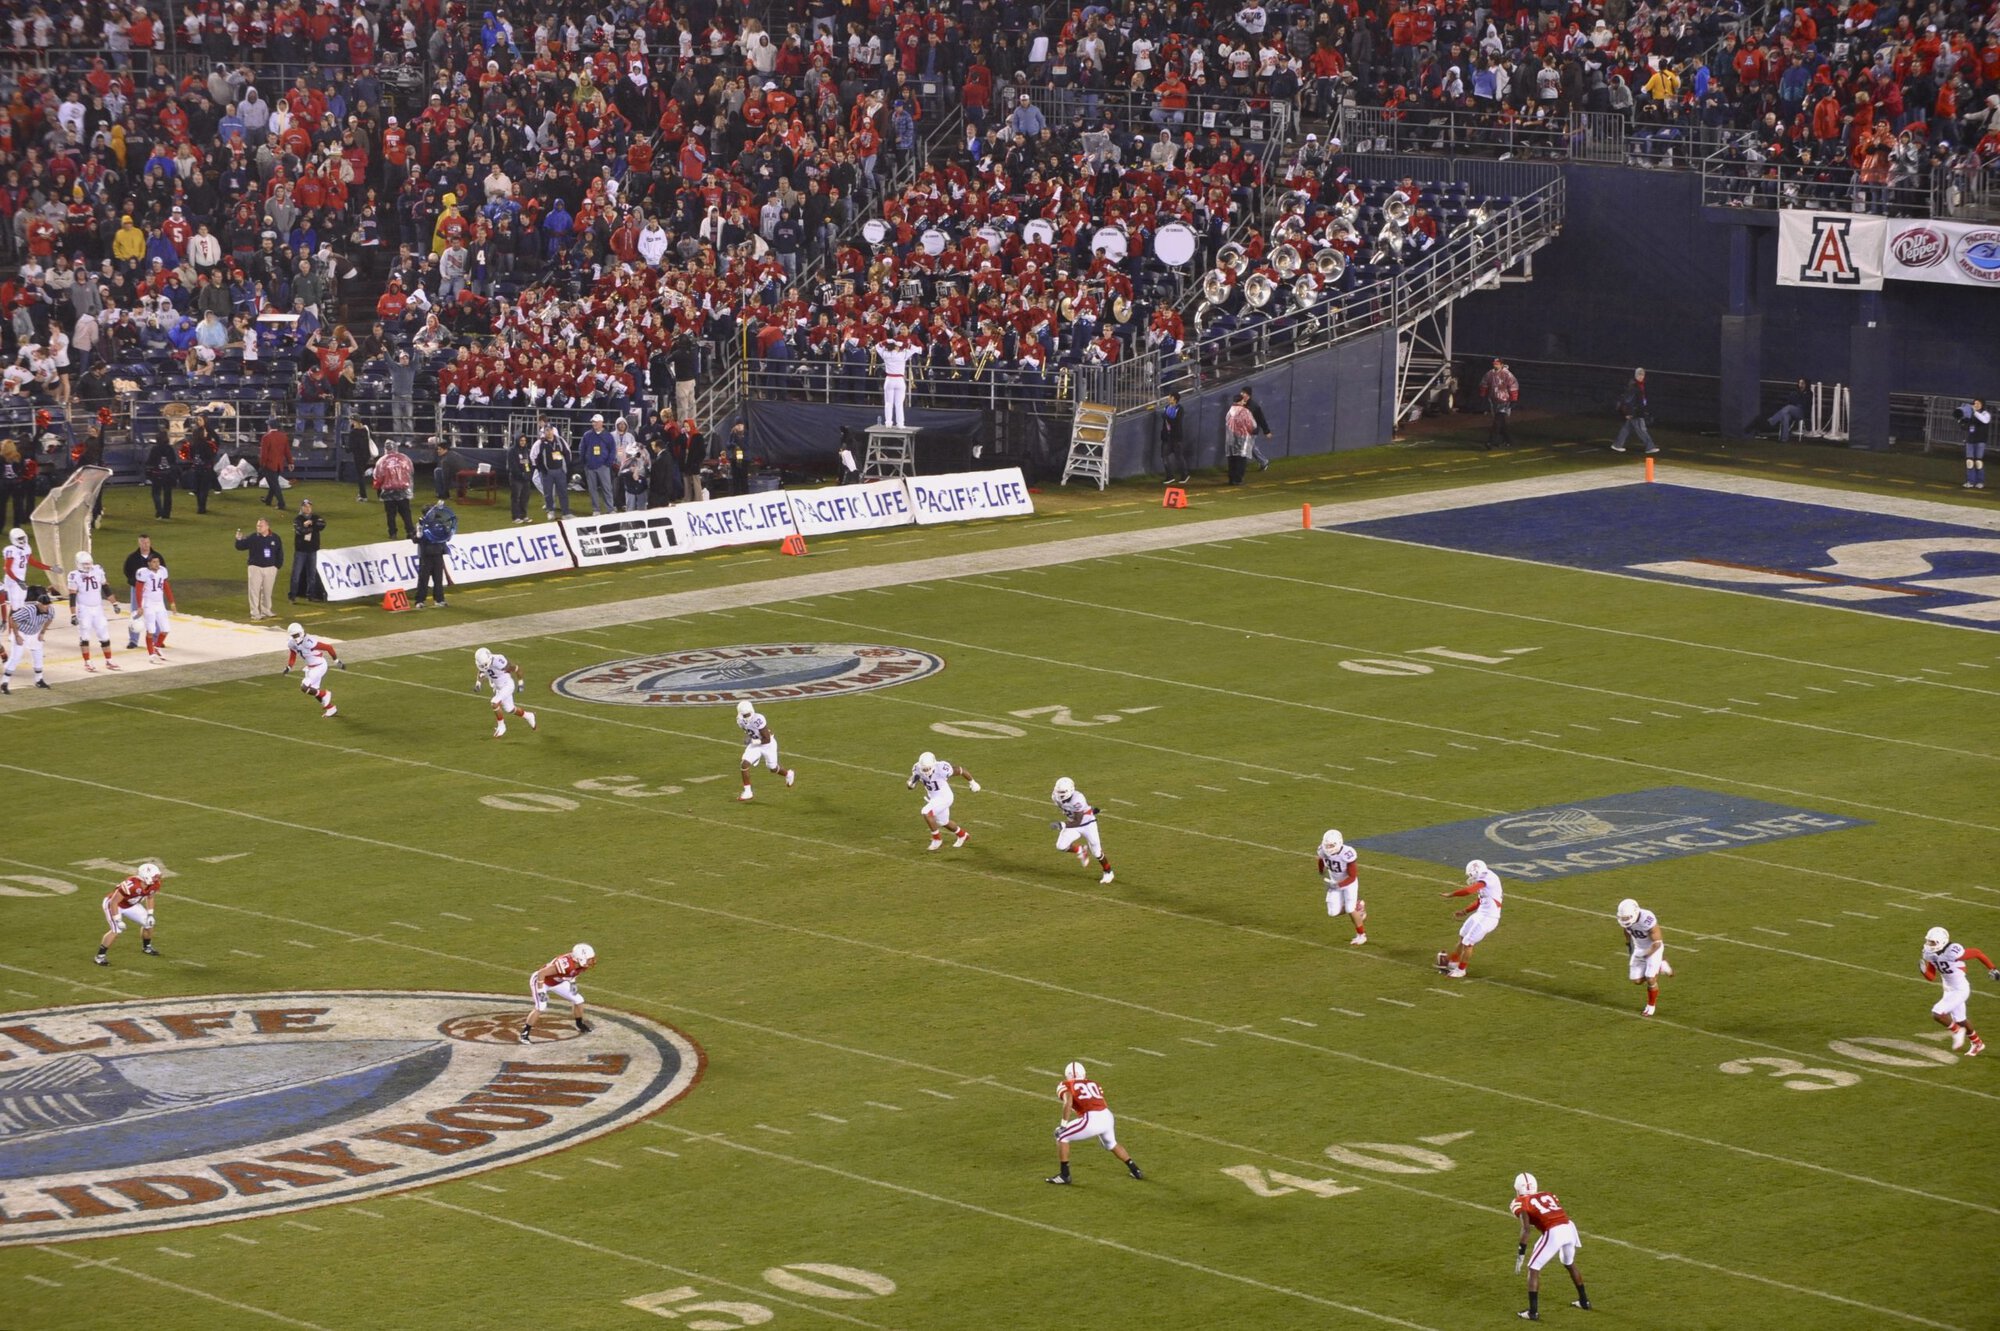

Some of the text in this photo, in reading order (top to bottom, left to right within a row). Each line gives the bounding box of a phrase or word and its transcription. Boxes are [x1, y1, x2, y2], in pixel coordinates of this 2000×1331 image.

[173, 228, 183, 243] 5
[1901, 237, 1939, 262] Pepper
[1914, 234, 1929, 248] Dr
[476, 250, 486, 265] 4
[1800, 216, 1860, 285] A
[794, 490, 908, 523] PACIFIC LIFE
[914, 481, 1026, 513] PACIFIC LIFE
[1168, 491, 1179, 507] G
[686, 502, 792, 537] PACIFIC LIFE
[576, 517, 678, 557] ESPN
[790, 537, 804, 555] 10
[447, 534, 564, 571] PACIFIC LIFE
[82, 576, 98, 591] 76
[321, 553, 420, 589] PACIFIC LIF
[390, 591, 408, 609] 20
[576, 646, 818, 684] PACIFIC LIFE
[643, 660, 922, 702] HOLIDAY BOWL
[753, 718, 763, 728] 32
[1490, 813, 1848, 877] PACIFIC LIFE
[1933, 960, 1953, 974] 12
[0, 1008, 336, 1055] LIFE
[349, 1054, 632, 1156] BOWL
[1073, 1082, 1104, 1100] 30
[1529, 1194, 1562, 1215] 13
